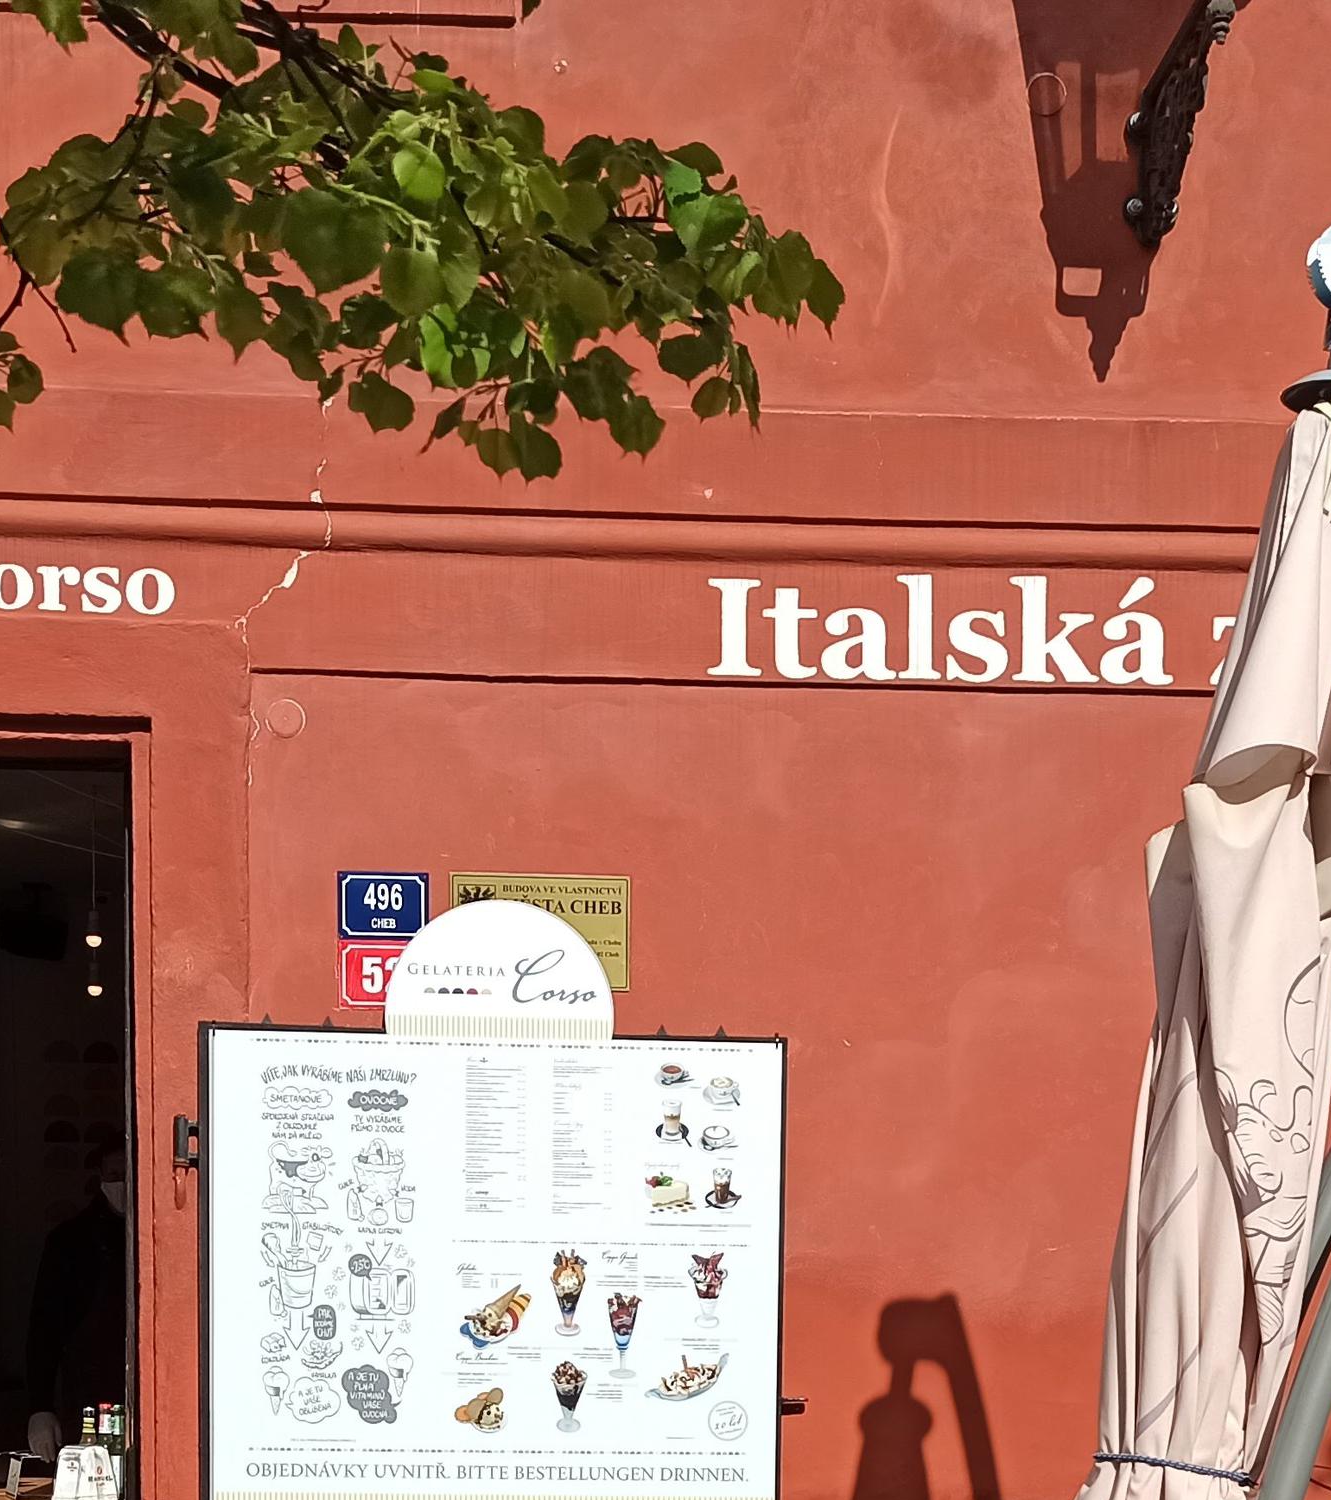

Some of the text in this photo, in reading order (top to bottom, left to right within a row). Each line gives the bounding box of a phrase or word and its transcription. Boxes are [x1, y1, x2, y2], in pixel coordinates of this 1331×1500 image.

[707, 574, 1173, 686] Italská
[363, 882, 403, 911] 496
[502, 884, 622, 896] BUDOVA VE VLASTNICTVÍ
[570, 899, 622, 915] CHEB
[371, 917, 397, 929] CHEB
[407, 949, 597, 1004] GELATERIA Corso
[246, 1461, 749, 1483] OBJEDNÁVKY UVNITŘ. BITTE BESTELLUNGEN DRINNEN.
